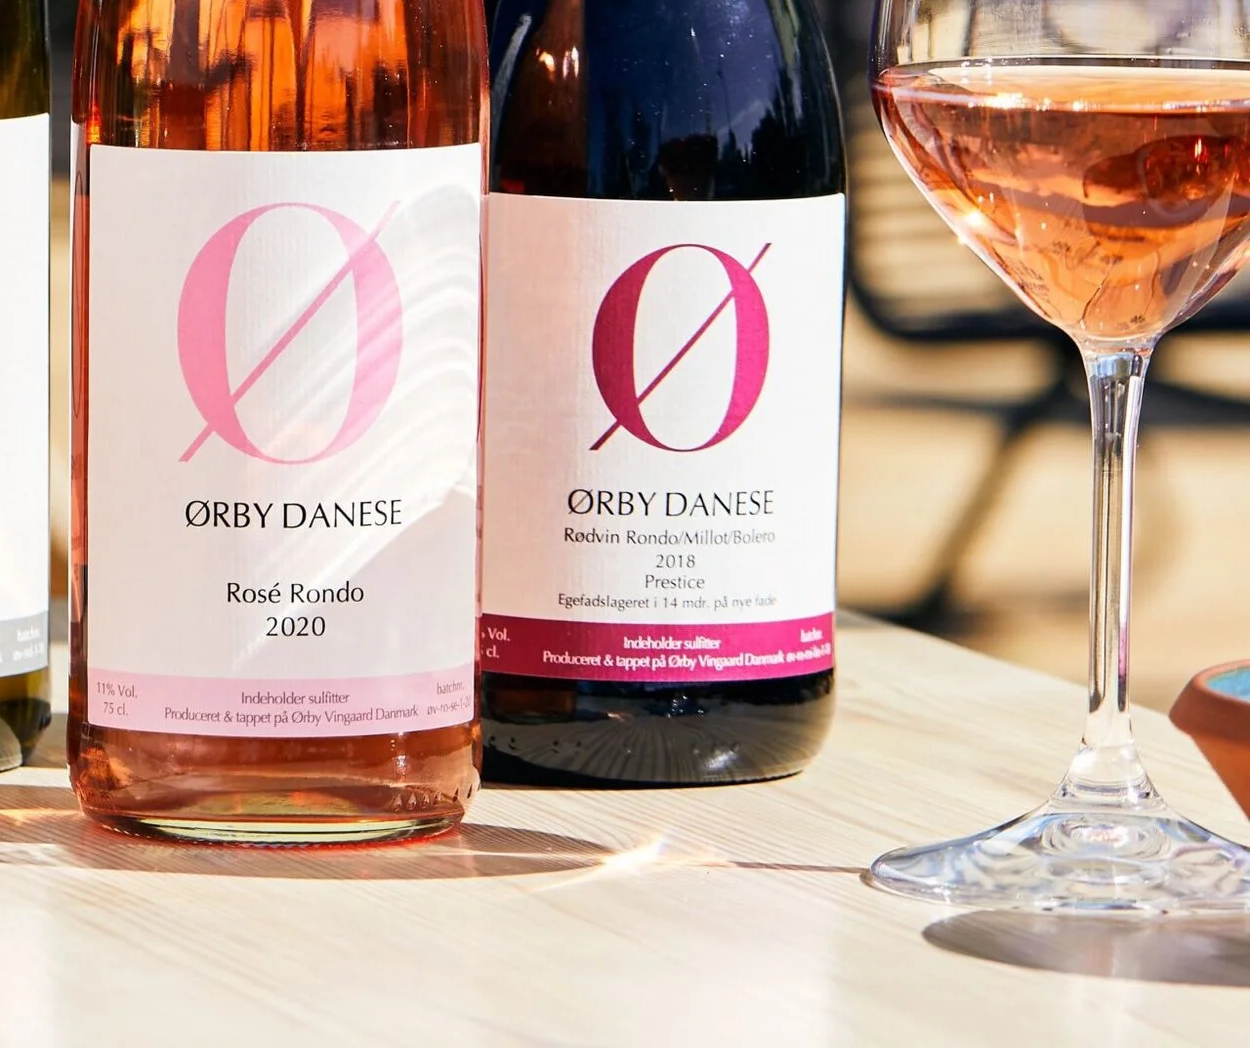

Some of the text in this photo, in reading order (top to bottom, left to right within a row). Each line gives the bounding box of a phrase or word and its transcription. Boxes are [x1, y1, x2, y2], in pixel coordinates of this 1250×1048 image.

[177, 200, 403, 465] Ø
[589, 242, 772, 452] Ø
[567, 489, 774, 517] ØRBY DANESE
[185, 499, 402, 529] ØRBY DANESE
[564, 527, 776, 545] Rødvin Rondo/Millot/Bolero
[656, 554, 695, 568] 2018
[645, 574, 705, 589] Prestice
[227, 581, 364, 603] Rosé Rondo
[558, 593, 649, 611] Egefadslageret
[663, 597, 678, 608] 14
[682, 596, 710, 608] mdr.
[714, 595, 728, 612] på
[732, 598, 752, 611] nye
[266, 616, 326, 636] 2020
[487, 626, 511, 642] Vol.
[486, 644, 500, 659] cl.
[623, 635, 721, 650] Indeholder sulfitter
[543, 650, 601, 666] Produceret
[603, 654, 614, 667] &
[616, 654, 650, 671] tappet
[652, 654, 666, 671] på
[668, 654, 697, 671] Ørby
[699, 653, 743, 671] Vingaard
[745, 650, 785, 666] Danmark
[97, 681, 138, 698] 11% Vol.
[241, 690, 350, 705] Indeholder sulfitter
[103, 701, 128, 716] 75 cl.
[164, 705, 418, 727] Produceret & tappet på Ørby Vingaard Danmark
